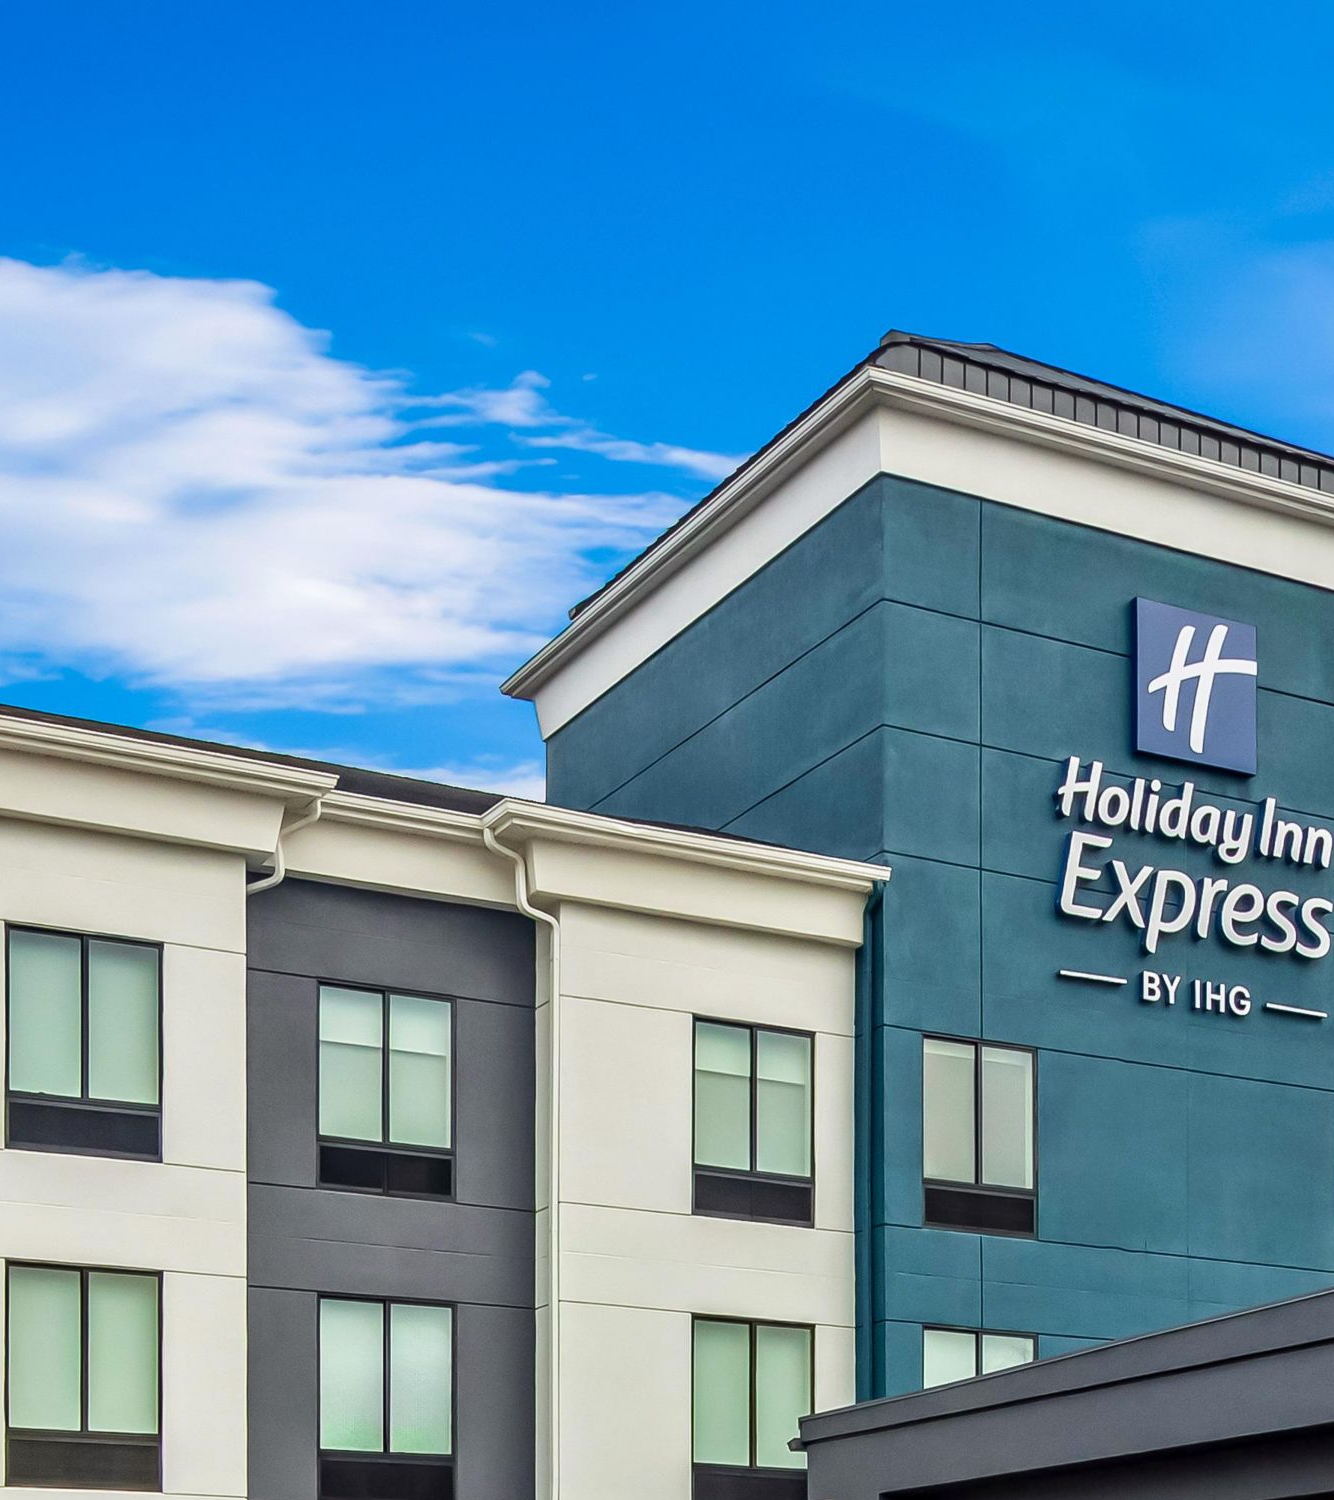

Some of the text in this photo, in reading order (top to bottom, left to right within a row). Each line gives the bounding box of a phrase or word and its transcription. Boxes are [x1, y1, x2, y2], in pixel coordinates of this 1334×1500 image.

[1056, 756, 1333, 868] Holiday Inn
[1058, 830, 1334, 959] Express
[1142, 970, 1252, 1016] BY IHG
